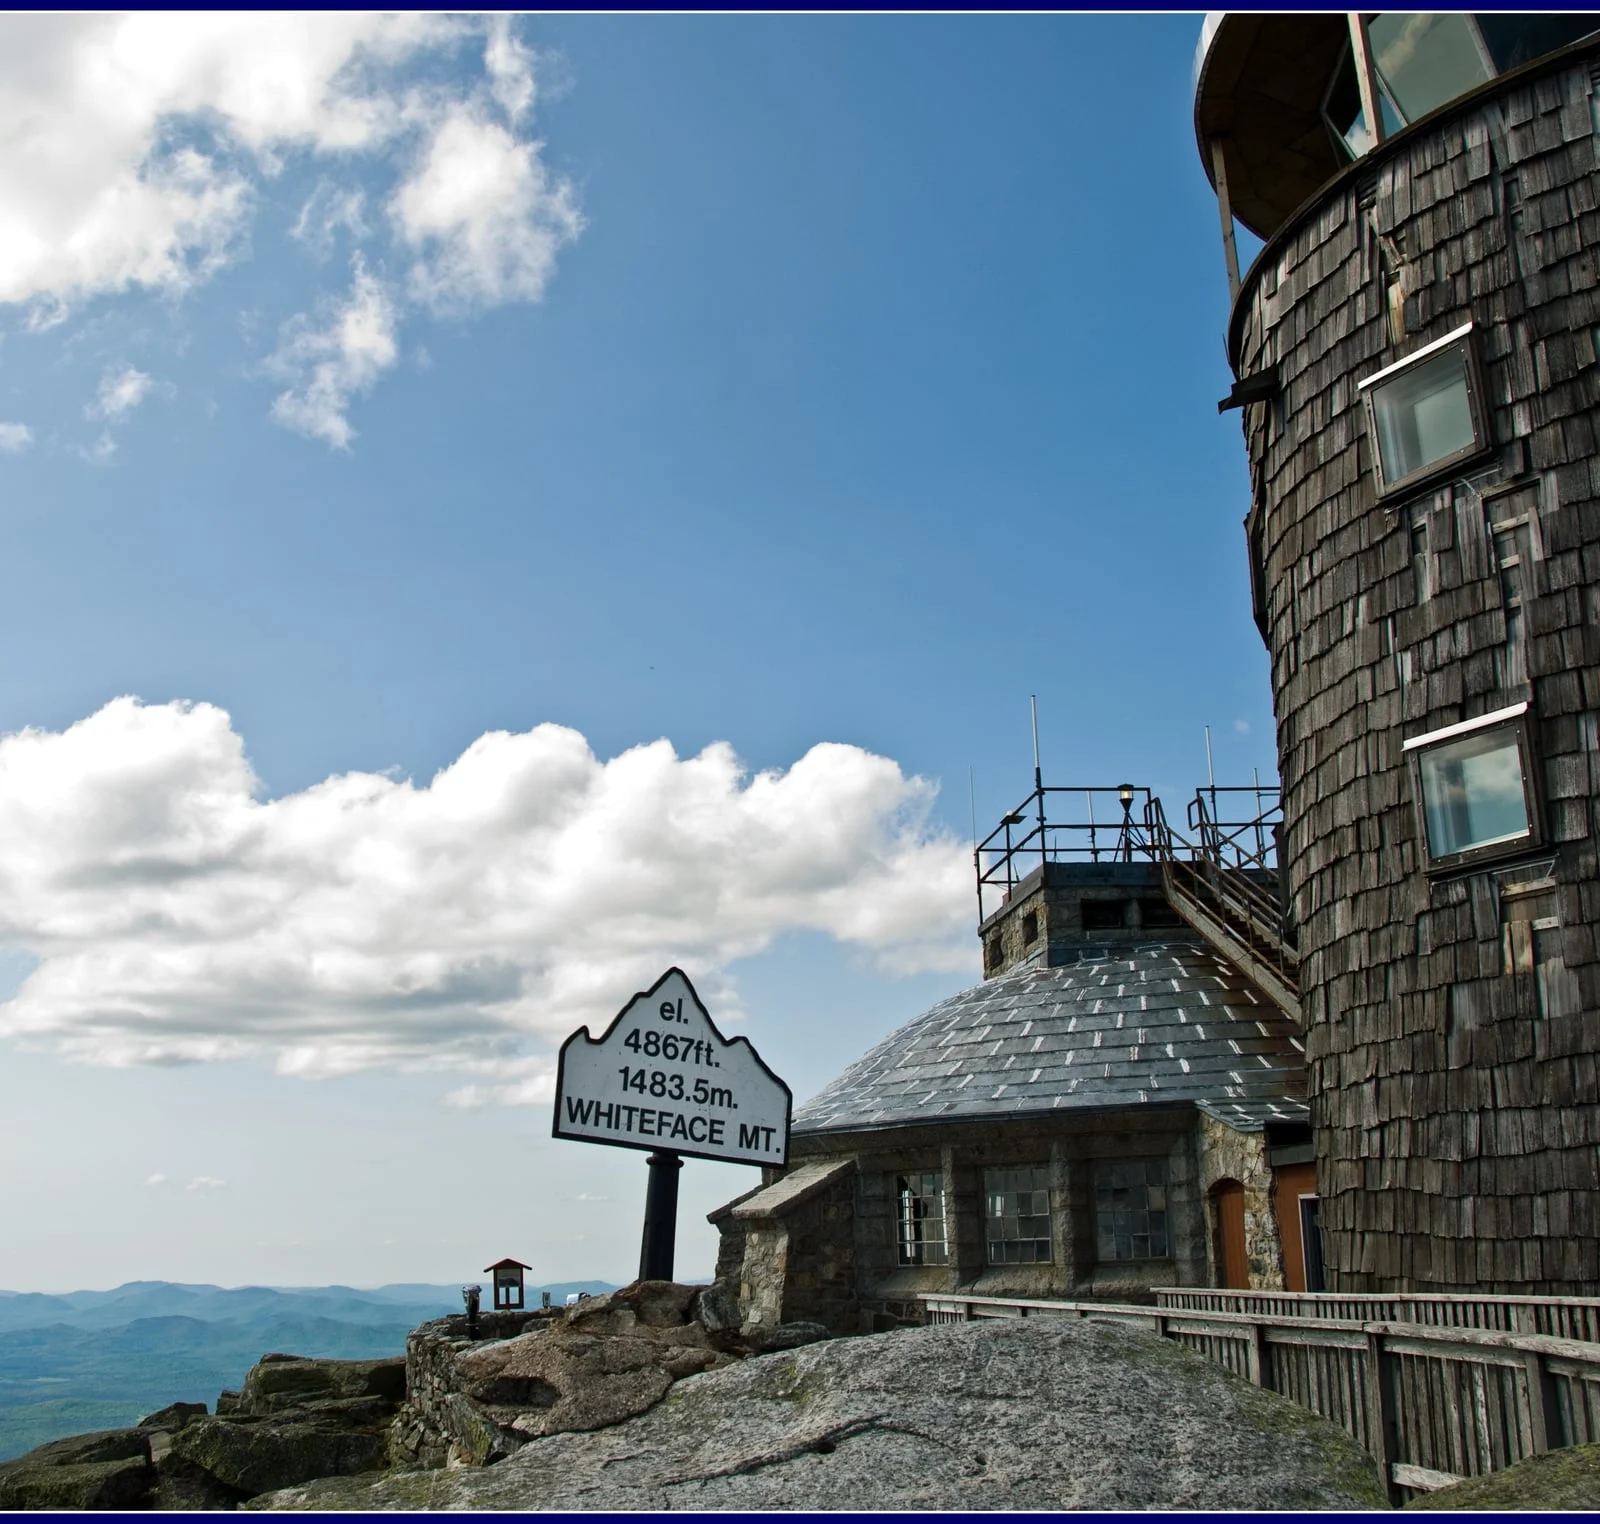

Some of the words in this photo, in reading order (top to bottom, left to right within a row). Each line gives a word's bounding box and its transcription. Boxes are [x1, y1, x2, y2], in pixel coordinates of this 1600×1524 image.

[659, 998, 688, 1024] el.
[624, 1028, 720, 1068] 4867ft.
[619, 1066, 738, 1109] 1483.5m.
[566, 1096, 725, 1145] WHITEFACE
[739, 1123, 781, 1153] MT.
